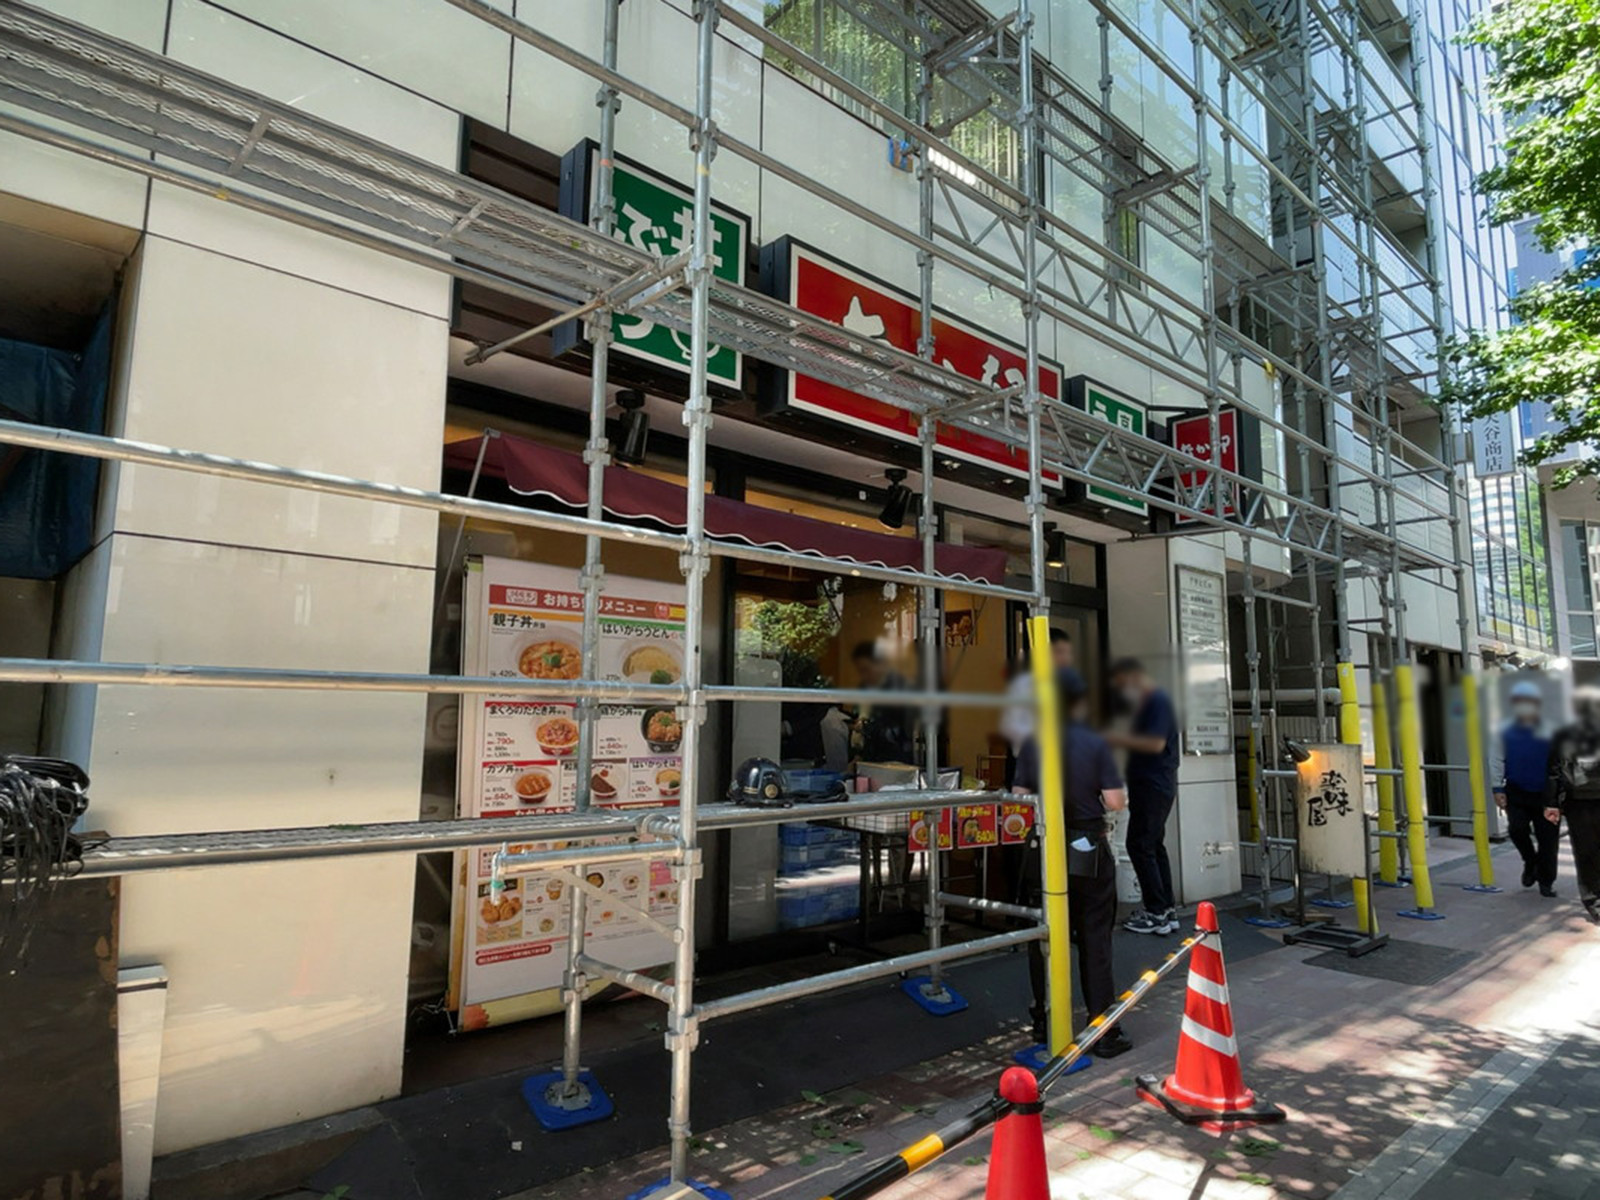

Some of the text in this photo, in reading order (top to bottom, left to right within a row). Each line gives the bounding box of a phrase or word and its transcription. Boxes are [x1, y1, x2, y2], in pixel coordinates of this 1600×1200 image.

[543, 593, 647, 613] お持ちりメニュー
